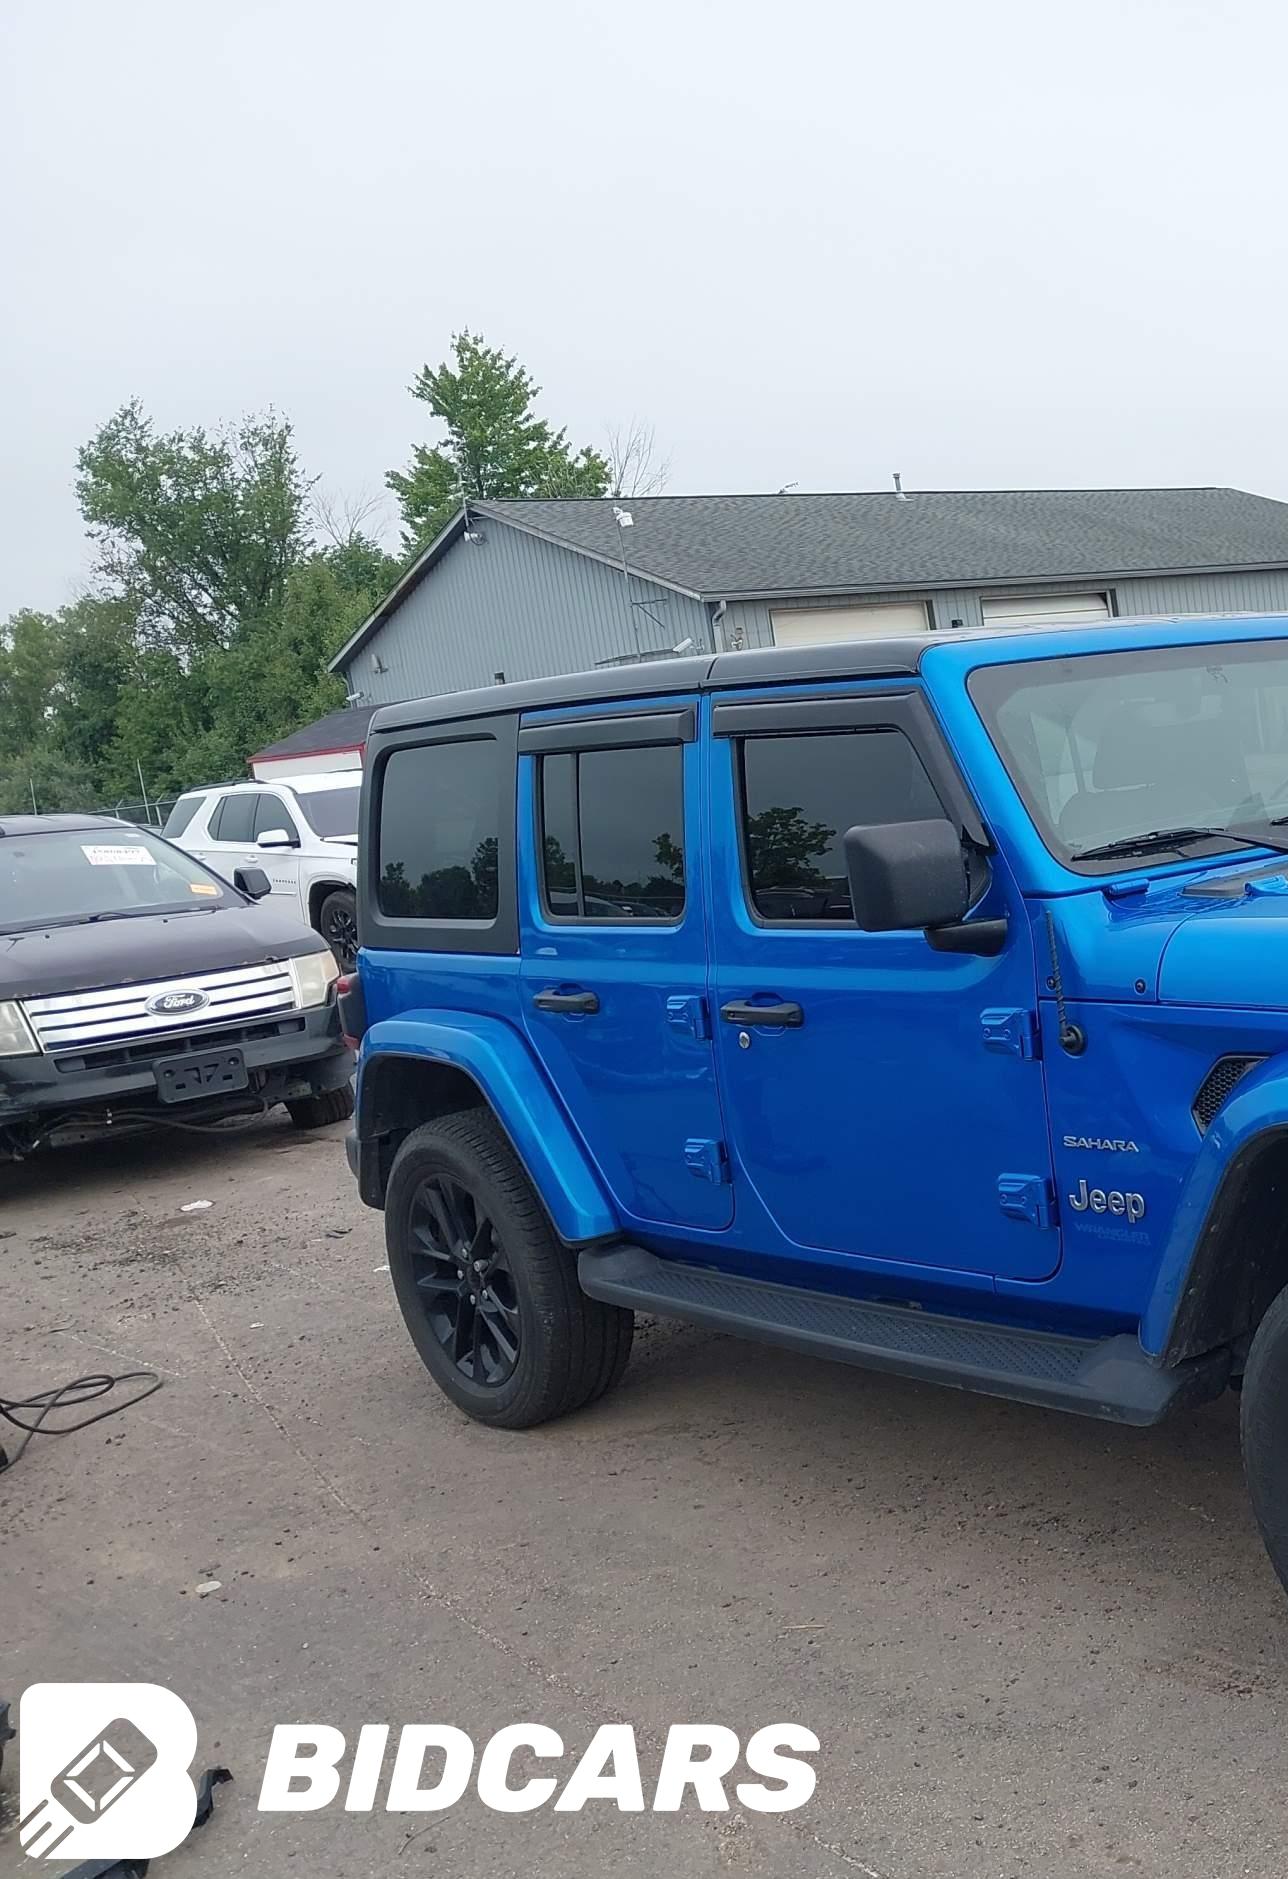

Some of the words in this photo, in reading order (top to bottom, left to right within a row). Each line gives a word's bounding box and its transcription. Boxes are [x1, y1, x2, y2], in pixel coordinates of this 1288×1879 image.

[163, 994, 195, 1009] Ford
[1063, 1135, 1139, 1152] SAHARA
[1068, 1179, 1145, 1223] Jeep
